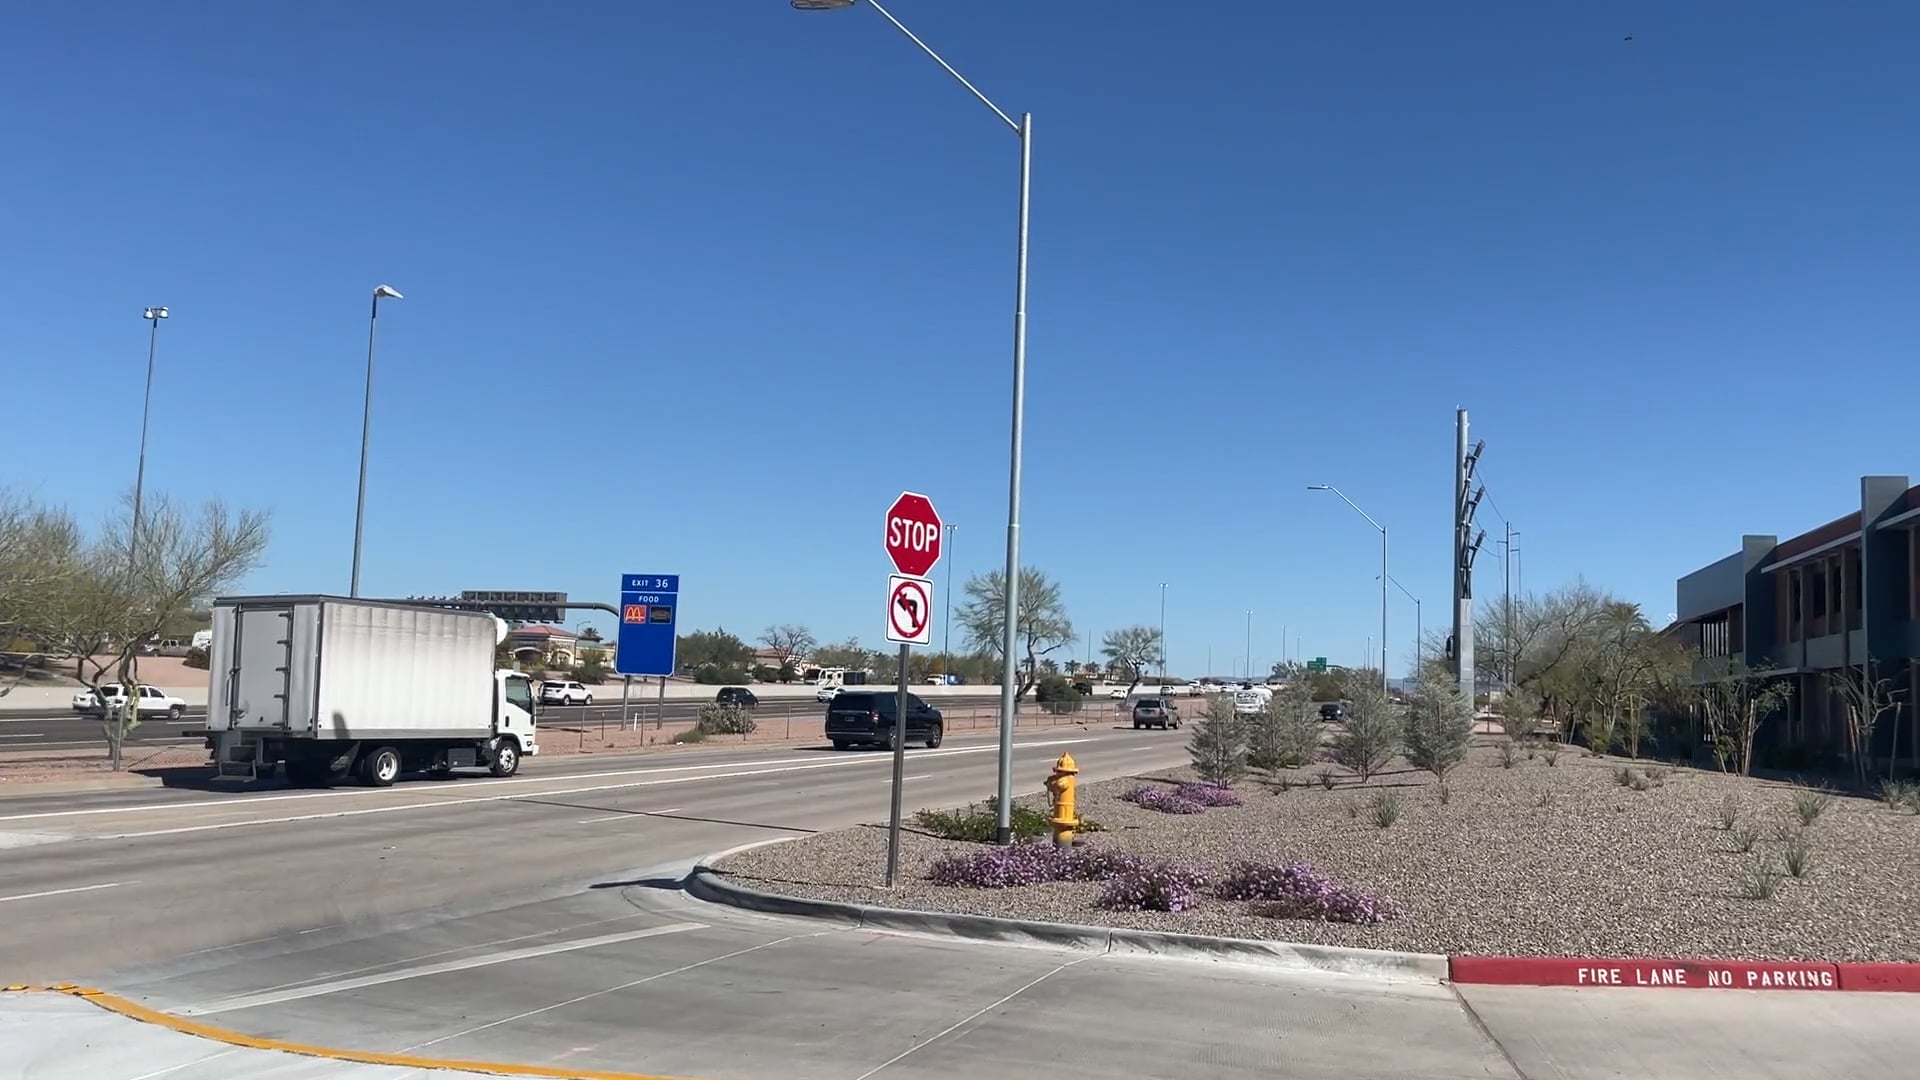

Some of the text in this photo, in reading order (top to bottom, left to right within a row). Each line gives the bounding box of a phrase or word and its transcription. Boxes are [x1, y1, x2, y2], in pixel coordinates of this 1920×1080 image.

[889, 516, 938, 553] STOP
[631, 578, 669, 588] EXIT 36
[638, 595, 660, 603] FOOD
[1578, 968, 1833, 987] FIRE LANE NO PARKING
